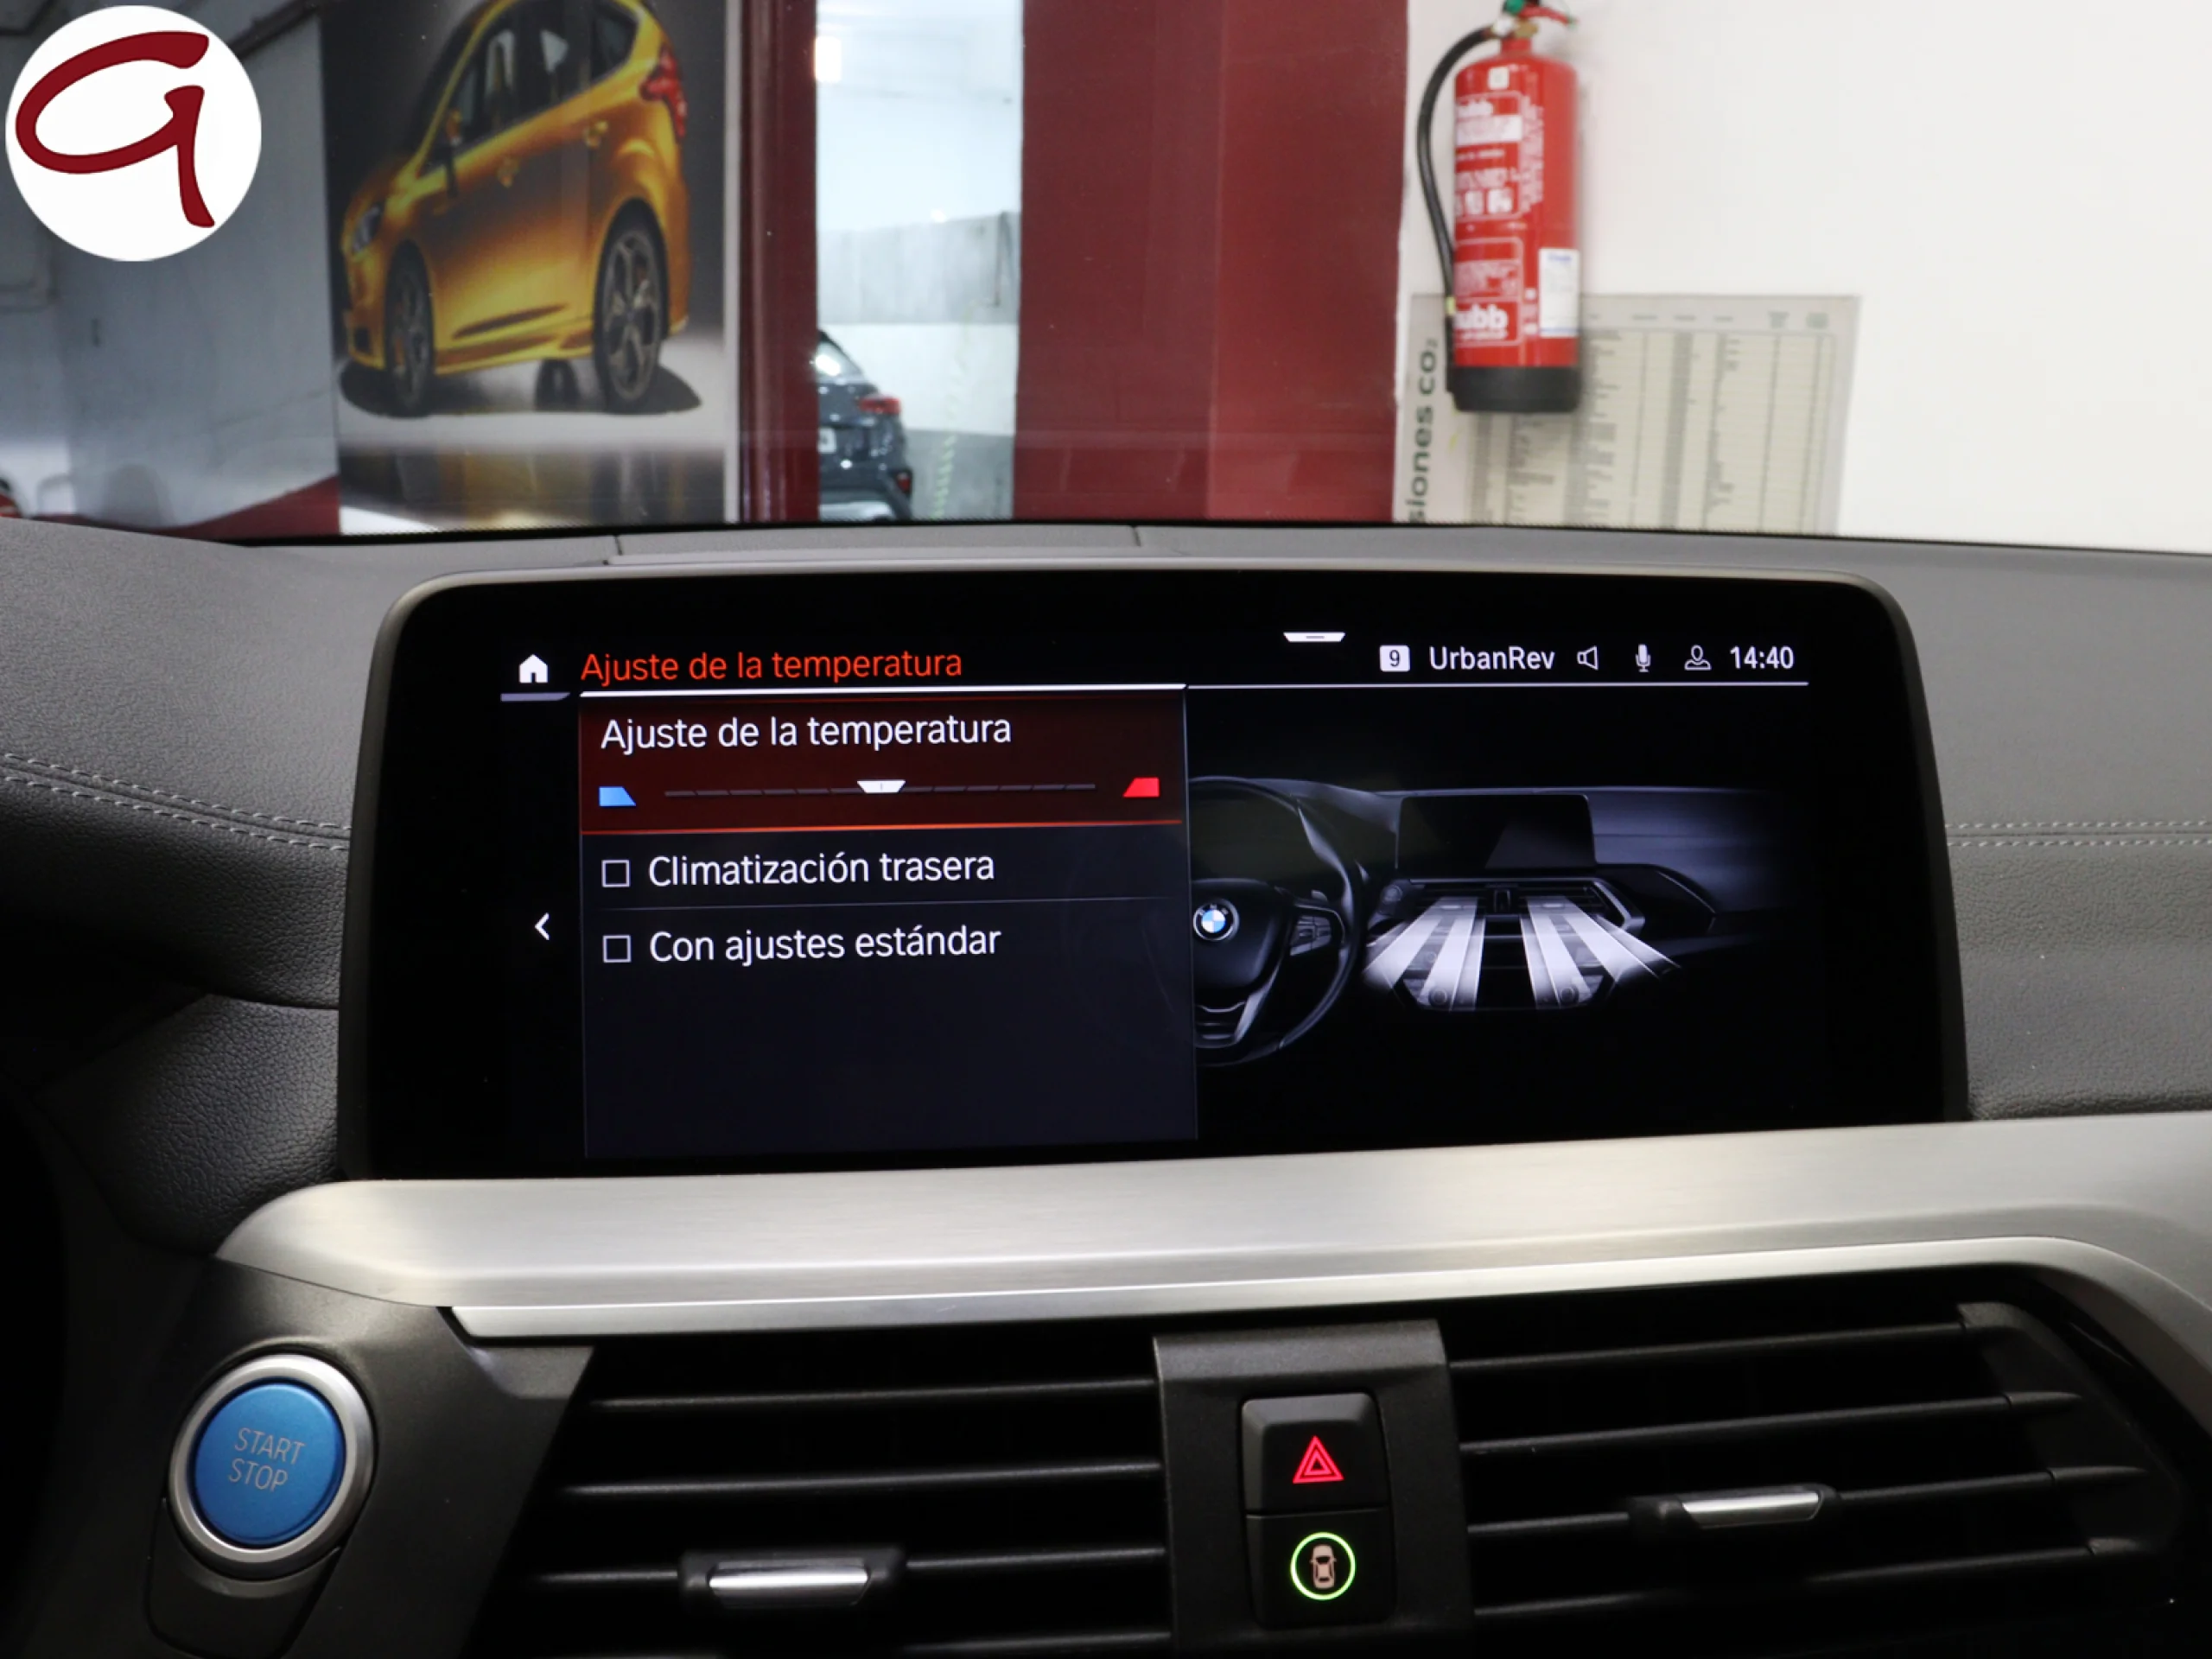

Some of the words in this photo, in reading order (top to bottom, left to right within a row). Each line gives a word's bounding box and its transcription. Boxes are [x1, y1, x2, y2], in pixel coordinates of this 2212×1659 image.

[581, 653, 679, 685] Ajuste
[689, 652, 728, 680] de
[738, 651, 762, 679] la
[772, 650, 963, 684] temperatura
[1389, 649, 1401, 668] 9
[1429, 645, 1555, 671] UrbanRev
[1730, 645, 1795, 670] 14:40
[601, 718, 708, 755] Ajuste
[718, 716, 760, 747] de
[771, 715, 798, 747] la
[806, 715, 1012, 752] temperatura
[649, 851, 869, 887] Climatización
[879, 852, 995, 882] trasera
[649, 931, 715, 963] Con
[725, 929, 846, 966] ajustes
[855, 924, 1002, 957] estándar
[234, 1427, 305, 1464] START
[229, 1459, 288, 1491] STOP
